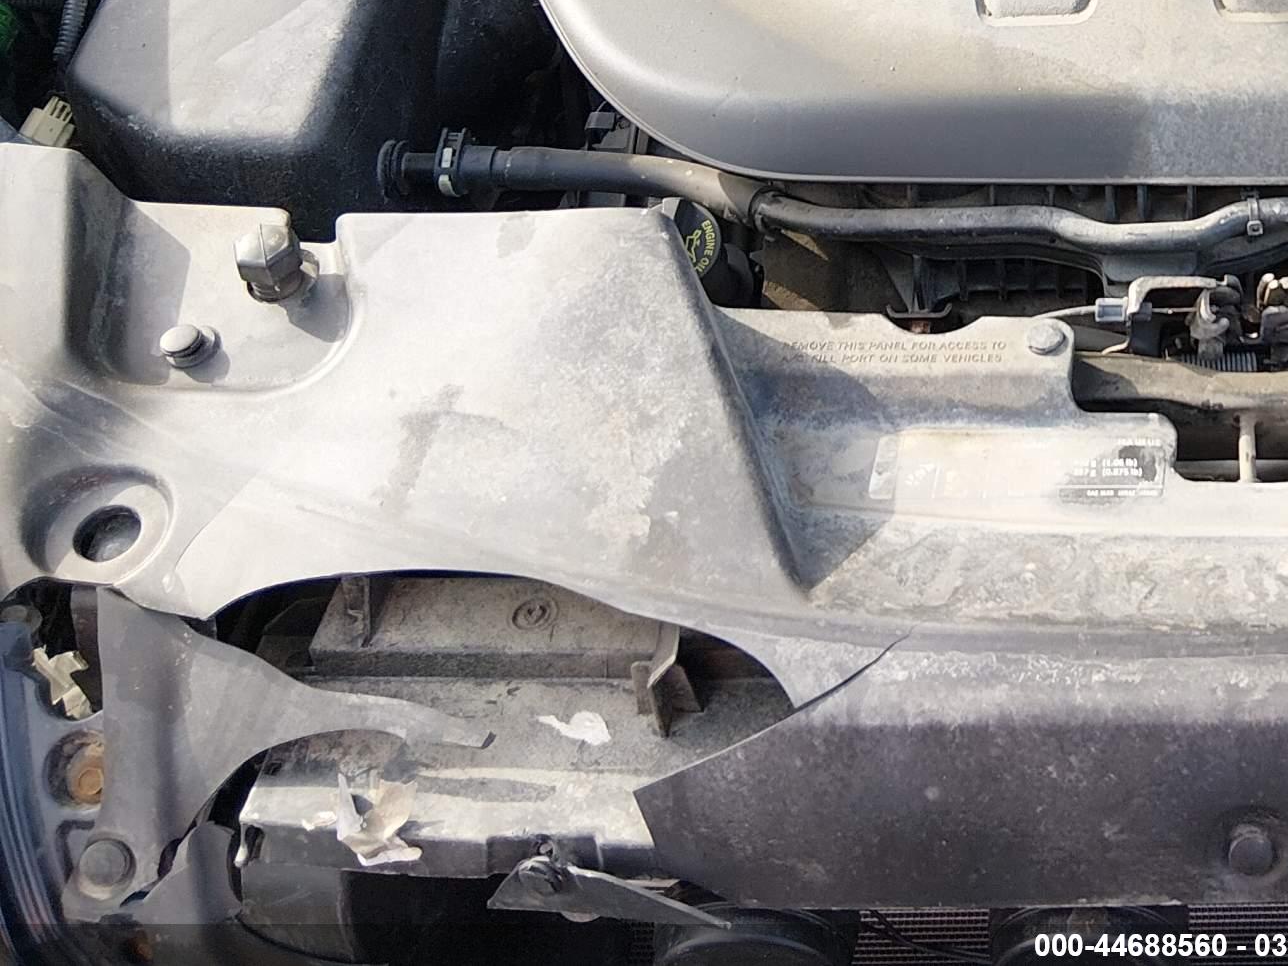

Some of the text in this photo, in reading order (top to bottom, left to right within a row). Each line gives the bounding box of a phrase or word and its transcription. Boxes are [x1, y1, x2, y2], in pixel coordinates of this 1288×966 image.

[694, 220, 715, 272] ENGINE OIL
[783, 340, 1007, 351] REMOVE THIS PANEL FOR ACCESS TO
[842, 354, 874, 363] PORT
[879, 354, 898, 363] ON
[902, 354, 937, 363] SOME
[944, 354, 1003, 363] VEHICLES
